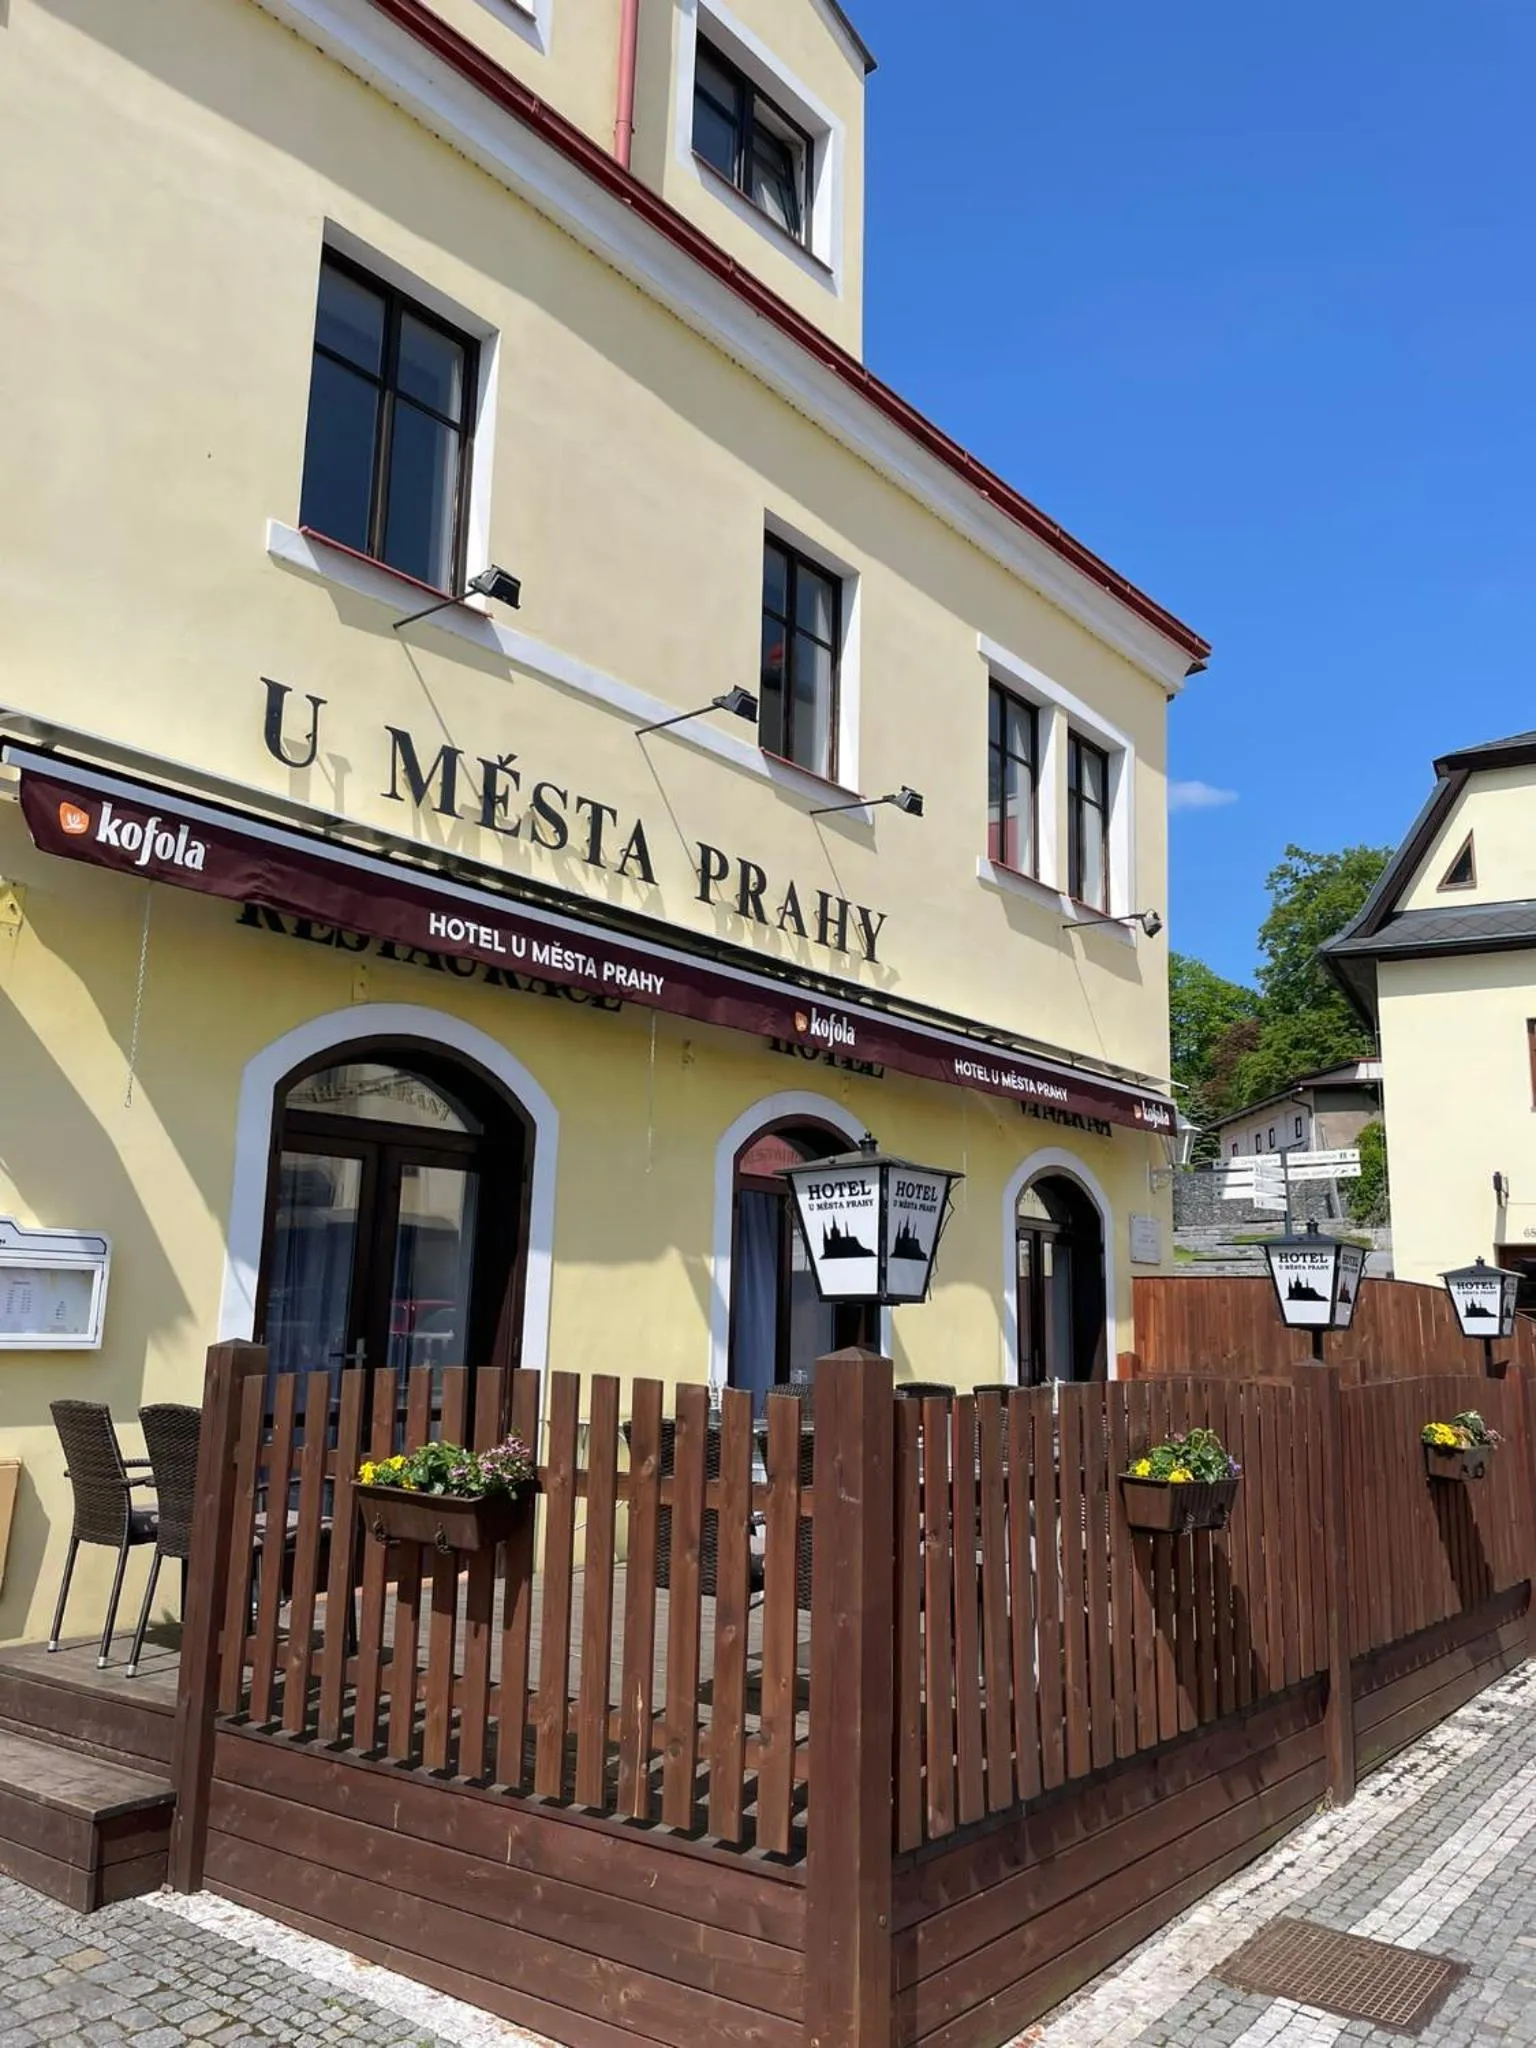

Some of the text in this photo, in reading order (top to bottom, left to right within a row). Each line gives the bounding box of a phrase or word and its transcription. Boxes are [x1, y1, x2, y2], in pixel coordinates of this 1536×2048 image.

[260, 676, 328, 768] U
[380, 725, 659, 887] MĚSTA
[694, 841, 888, 964] PRAHY
[95, 801, 207, 871] kofola
[429, 912, 665, 995] HOTEL U MĚSTA PRAHY
[810, 1007, 856, 1047] kofola
[954, 1059, 1069, 1102] HOTEL U MĚSTA PRAHY
[808, 1180, 871, 1200] HOTEL
[808, 1203, 816, 1211] U
[846, 1199, 874, 1208] PRAHY
[895, 1180, 938, 1202] HOTEL
[1279, 1253, 1328, 1263] HOTEL
[1456, 1281, 1496, 1290] HOTEL
